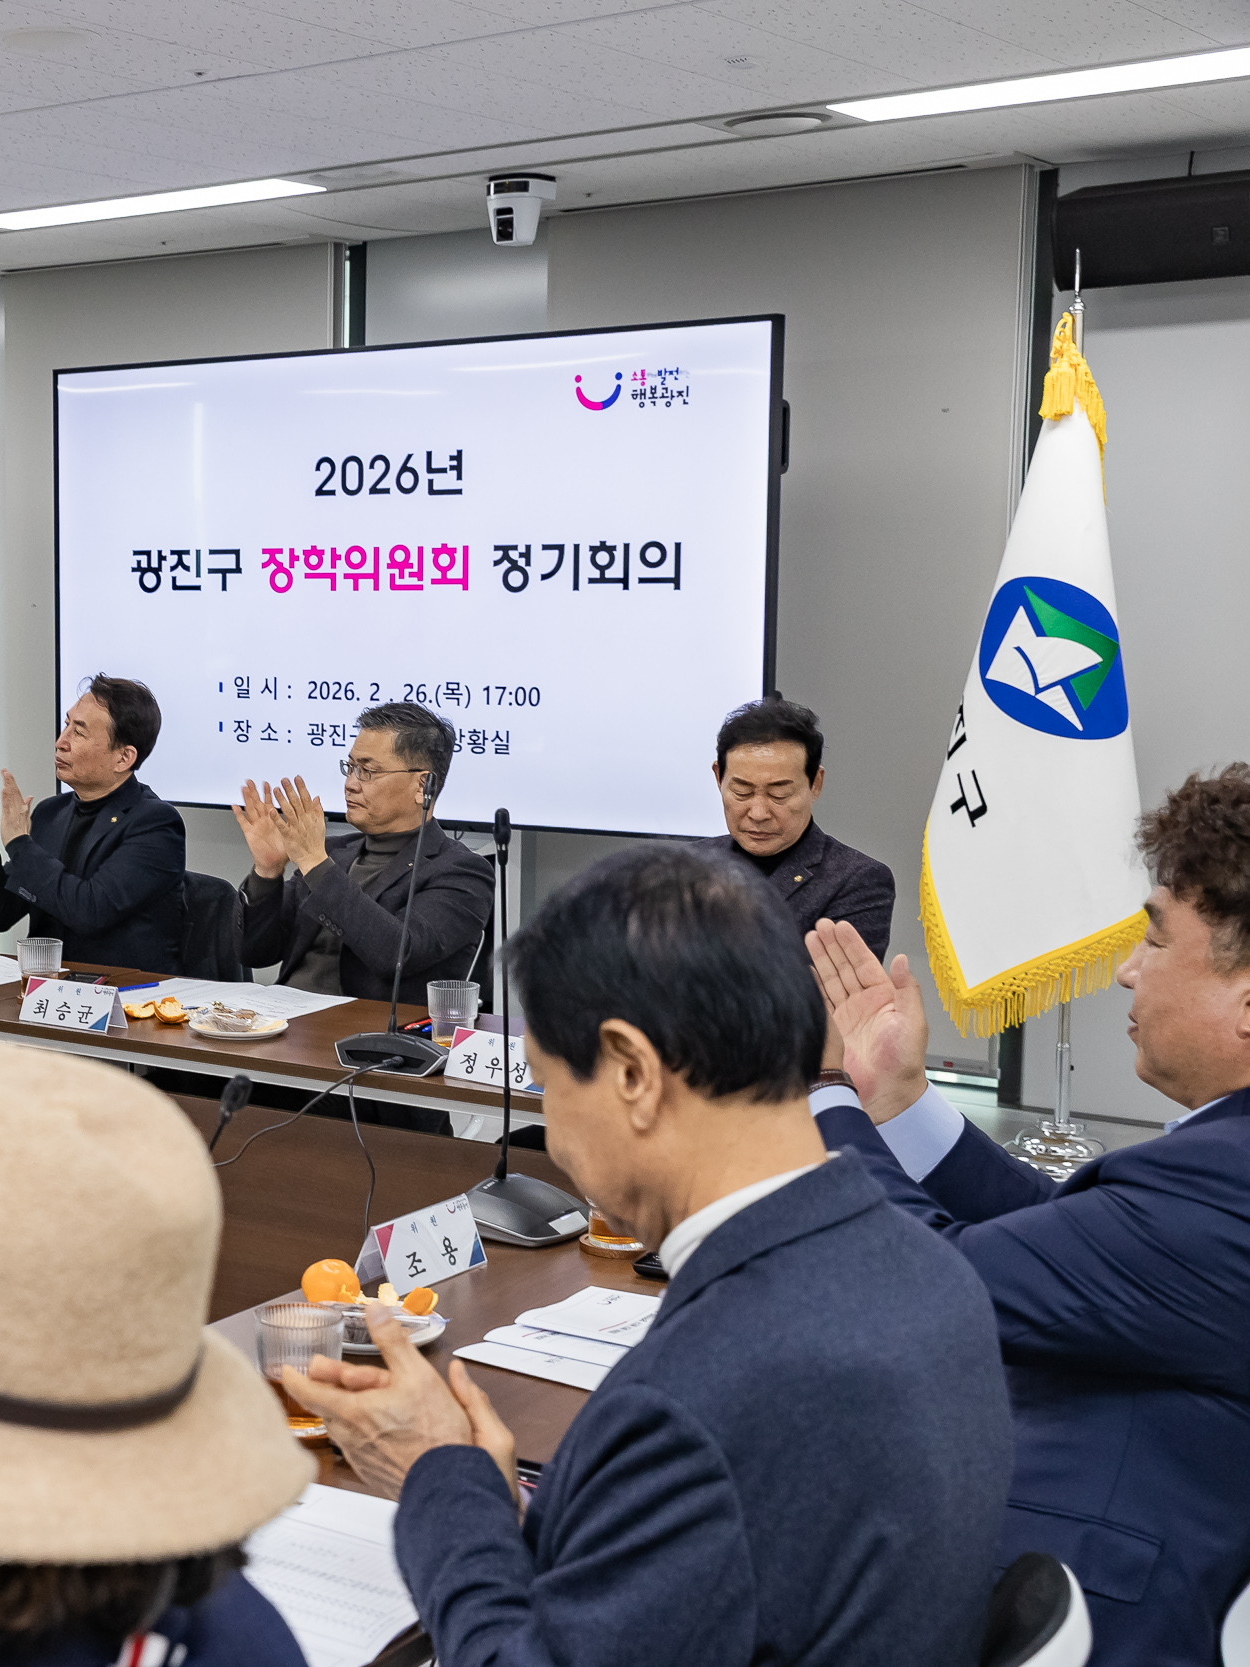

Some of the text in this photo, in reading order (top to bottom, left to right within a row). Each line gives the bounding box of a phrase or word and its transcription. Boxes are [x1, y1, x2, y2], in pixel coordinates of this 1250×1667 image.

[631, 385, 689, 408] 행복광진
[315, 449, 463, 497] 2026년
[131, 540, 682, 594] 광진구 장학위원회 정기회의
[308, 680, 361, 702] 2026.
[482, 686, 541, 707] 17:00
